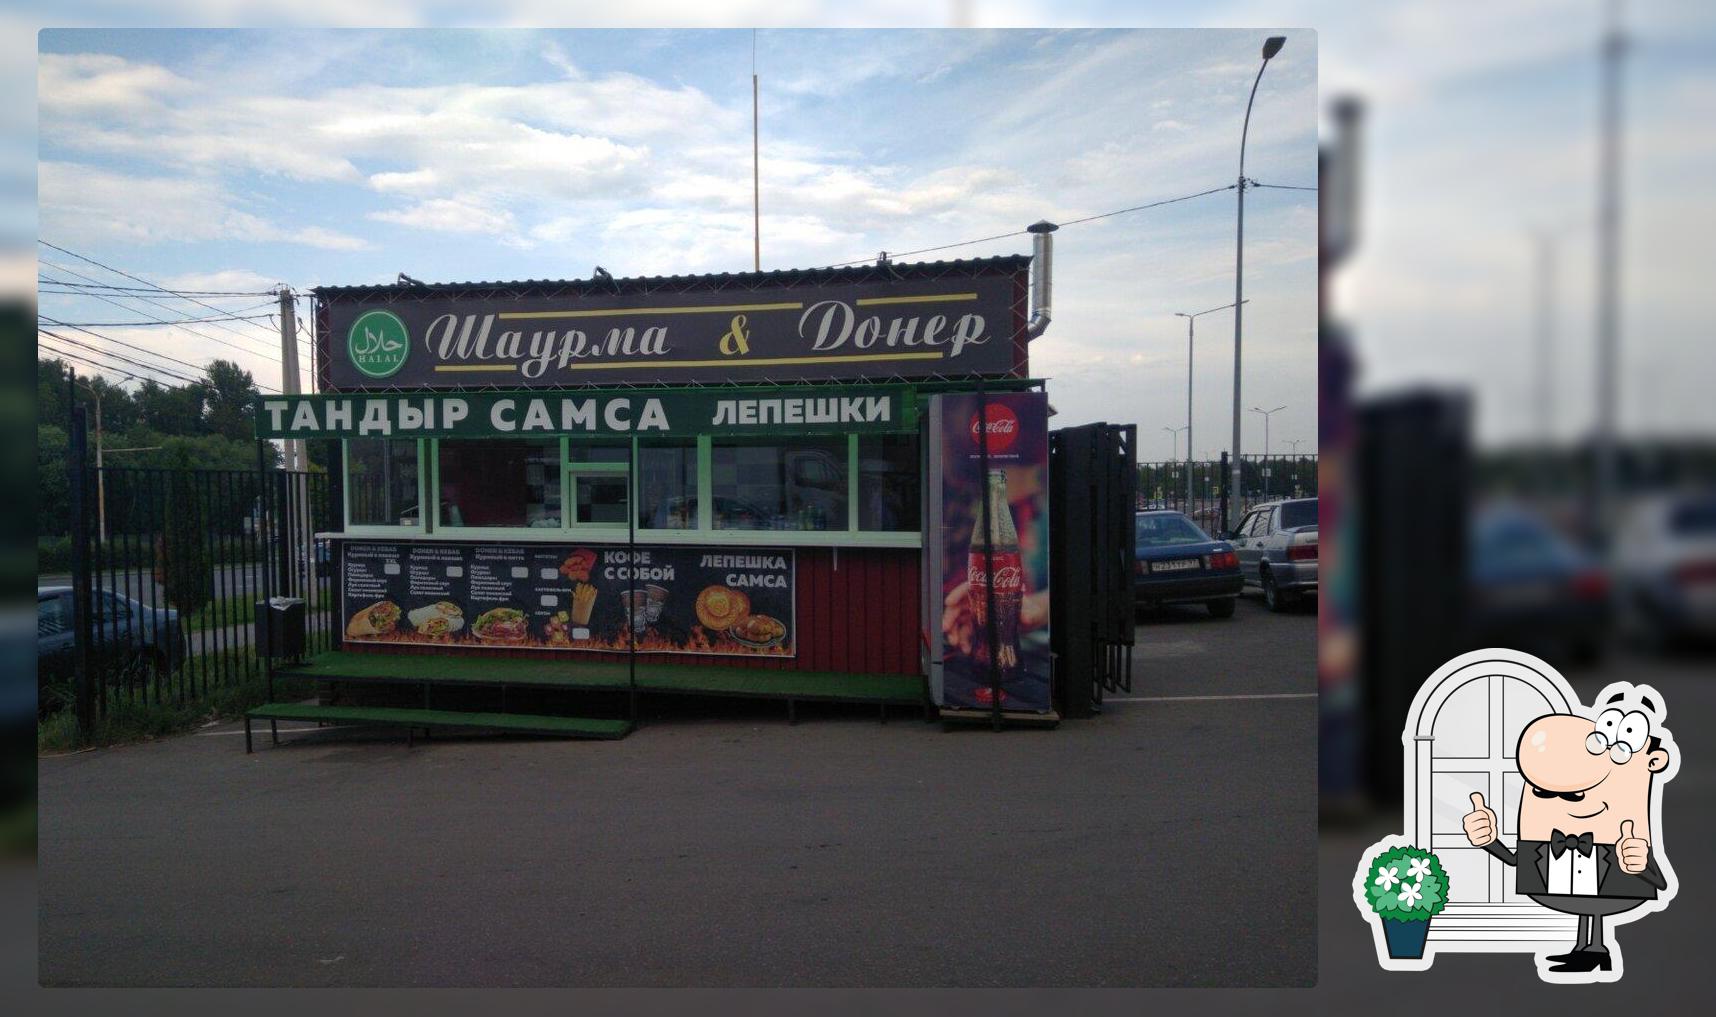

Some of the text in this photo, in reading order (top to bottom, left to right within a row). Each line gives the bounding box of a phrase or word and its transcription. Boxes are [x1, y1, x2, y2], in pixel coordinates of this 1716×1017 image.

[355, 326, 403, 354] حلال
[425, 300, 992, 378] Шаурма & Донер
[359, 354, 399, 363] HALAL
[265, 396, 891, 435] ТАНДЫР САМСА ЛЕПЕШКИ
[604, 551, 651, 564] КОФЕ
[700, 554, 787, 569] ЛЕПЕШКА
[617, 564, 675, 581] СОБОЙ
[725, 573, 787, 588] САМСА
